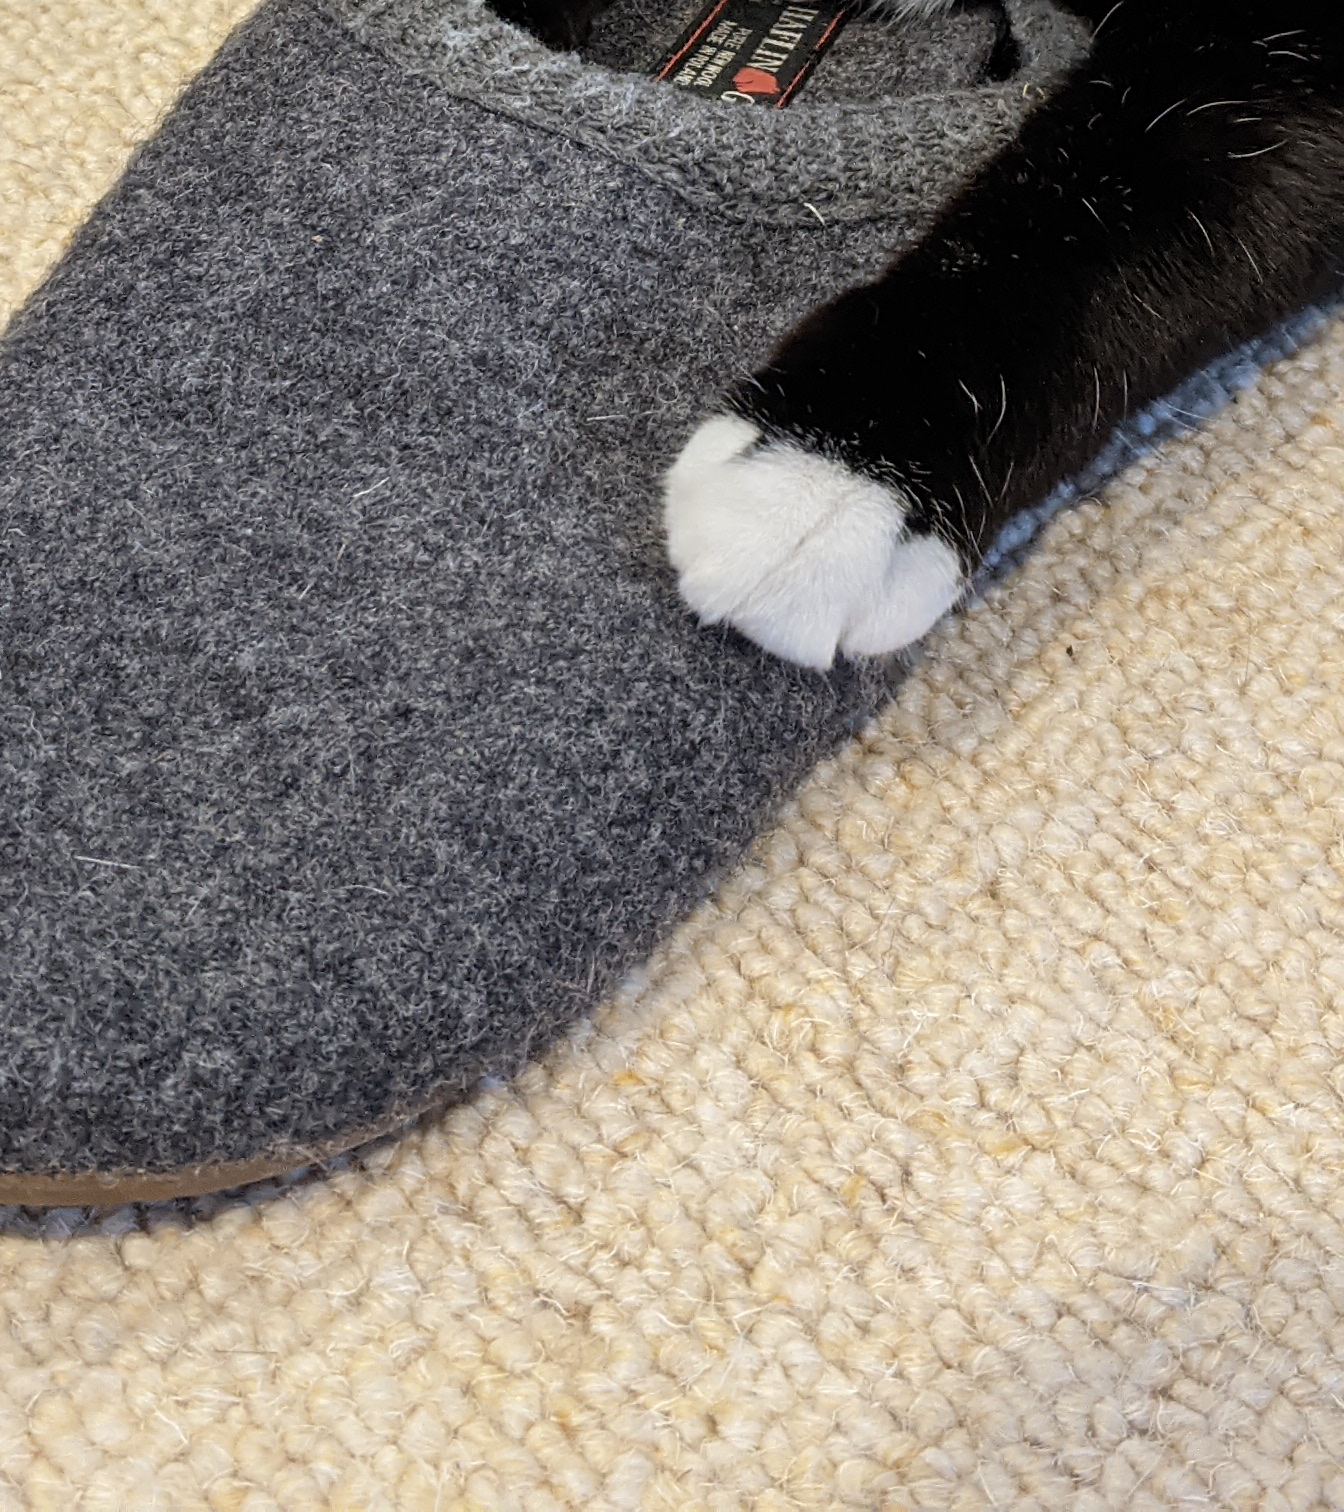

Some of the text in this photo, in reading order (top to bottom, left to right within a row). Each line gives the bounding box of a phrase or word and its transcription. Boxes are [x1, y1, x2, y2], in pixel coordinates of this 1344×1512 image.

[672, 19, 738, 86] MADE IN POLAND
[693, 28, 753, 87] PURE NEW WOOL
